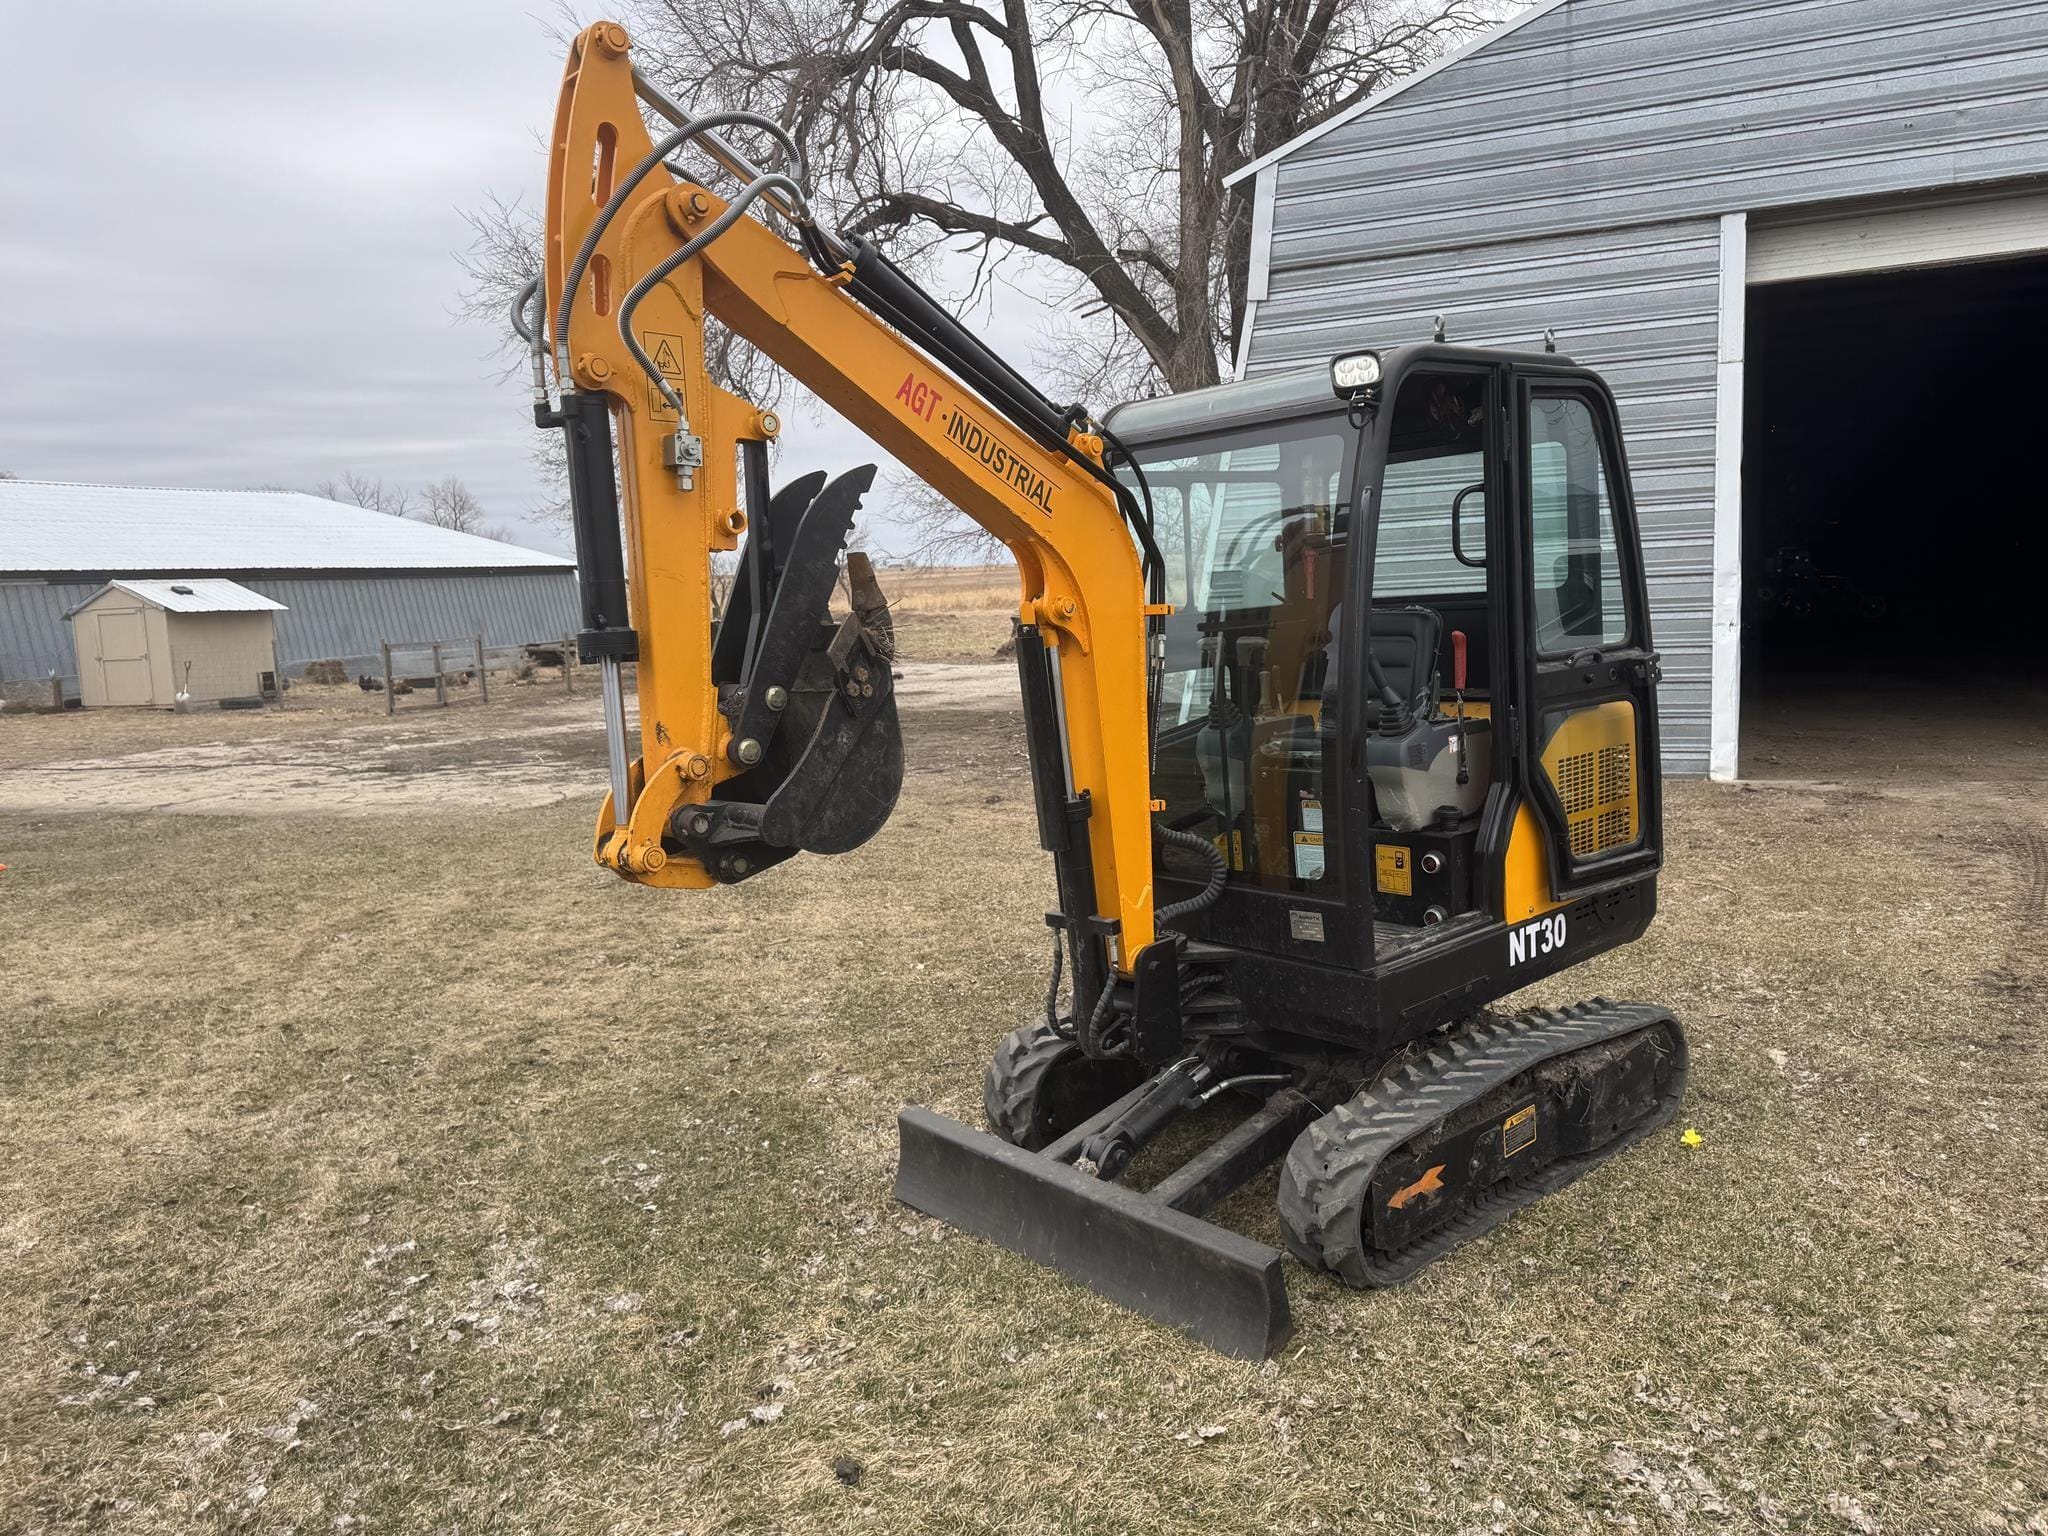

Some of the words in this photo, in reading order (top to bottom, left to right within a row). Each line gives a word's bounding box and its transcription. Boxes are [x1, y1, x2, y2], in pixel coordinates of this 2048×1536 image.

[896, 373, 942, 422] AGT
[947, 411, 1053, 514] INDUSTRIAL
[1509, 913, 1566, 966] NT30
